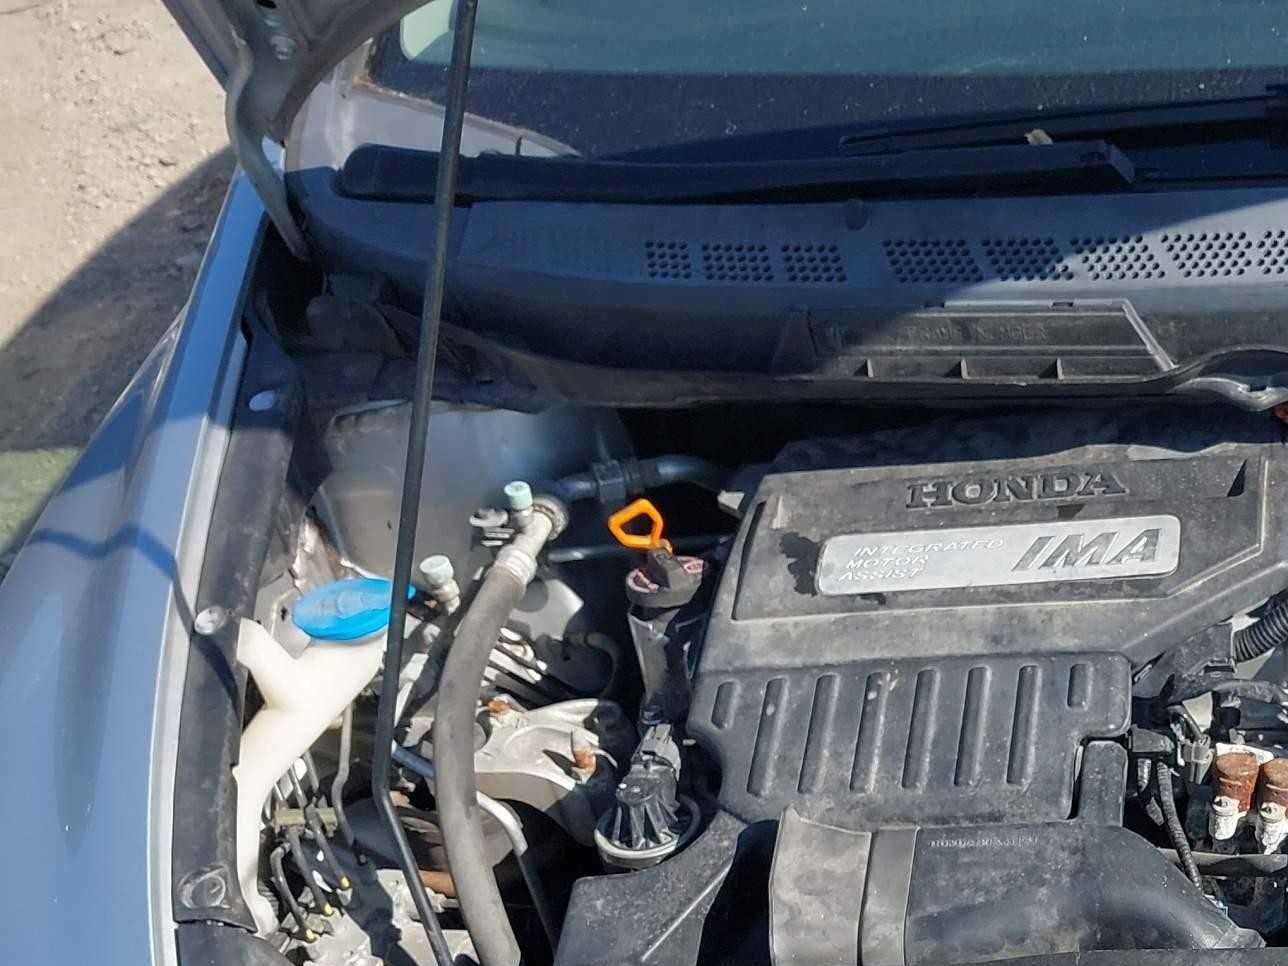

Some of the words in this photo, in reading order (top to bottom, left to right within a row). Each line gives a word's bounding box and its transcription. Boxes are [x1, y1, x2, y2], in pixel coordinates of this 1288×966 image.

[904, 471, 1130, 510] HONDA
[853, 538, 1005, 558] INTEGRATED
[1010, 527, 1163, 573] IMA
[845, 555, 929, 570] MOTOR
[838, 568, 925, 582] ASSIST
